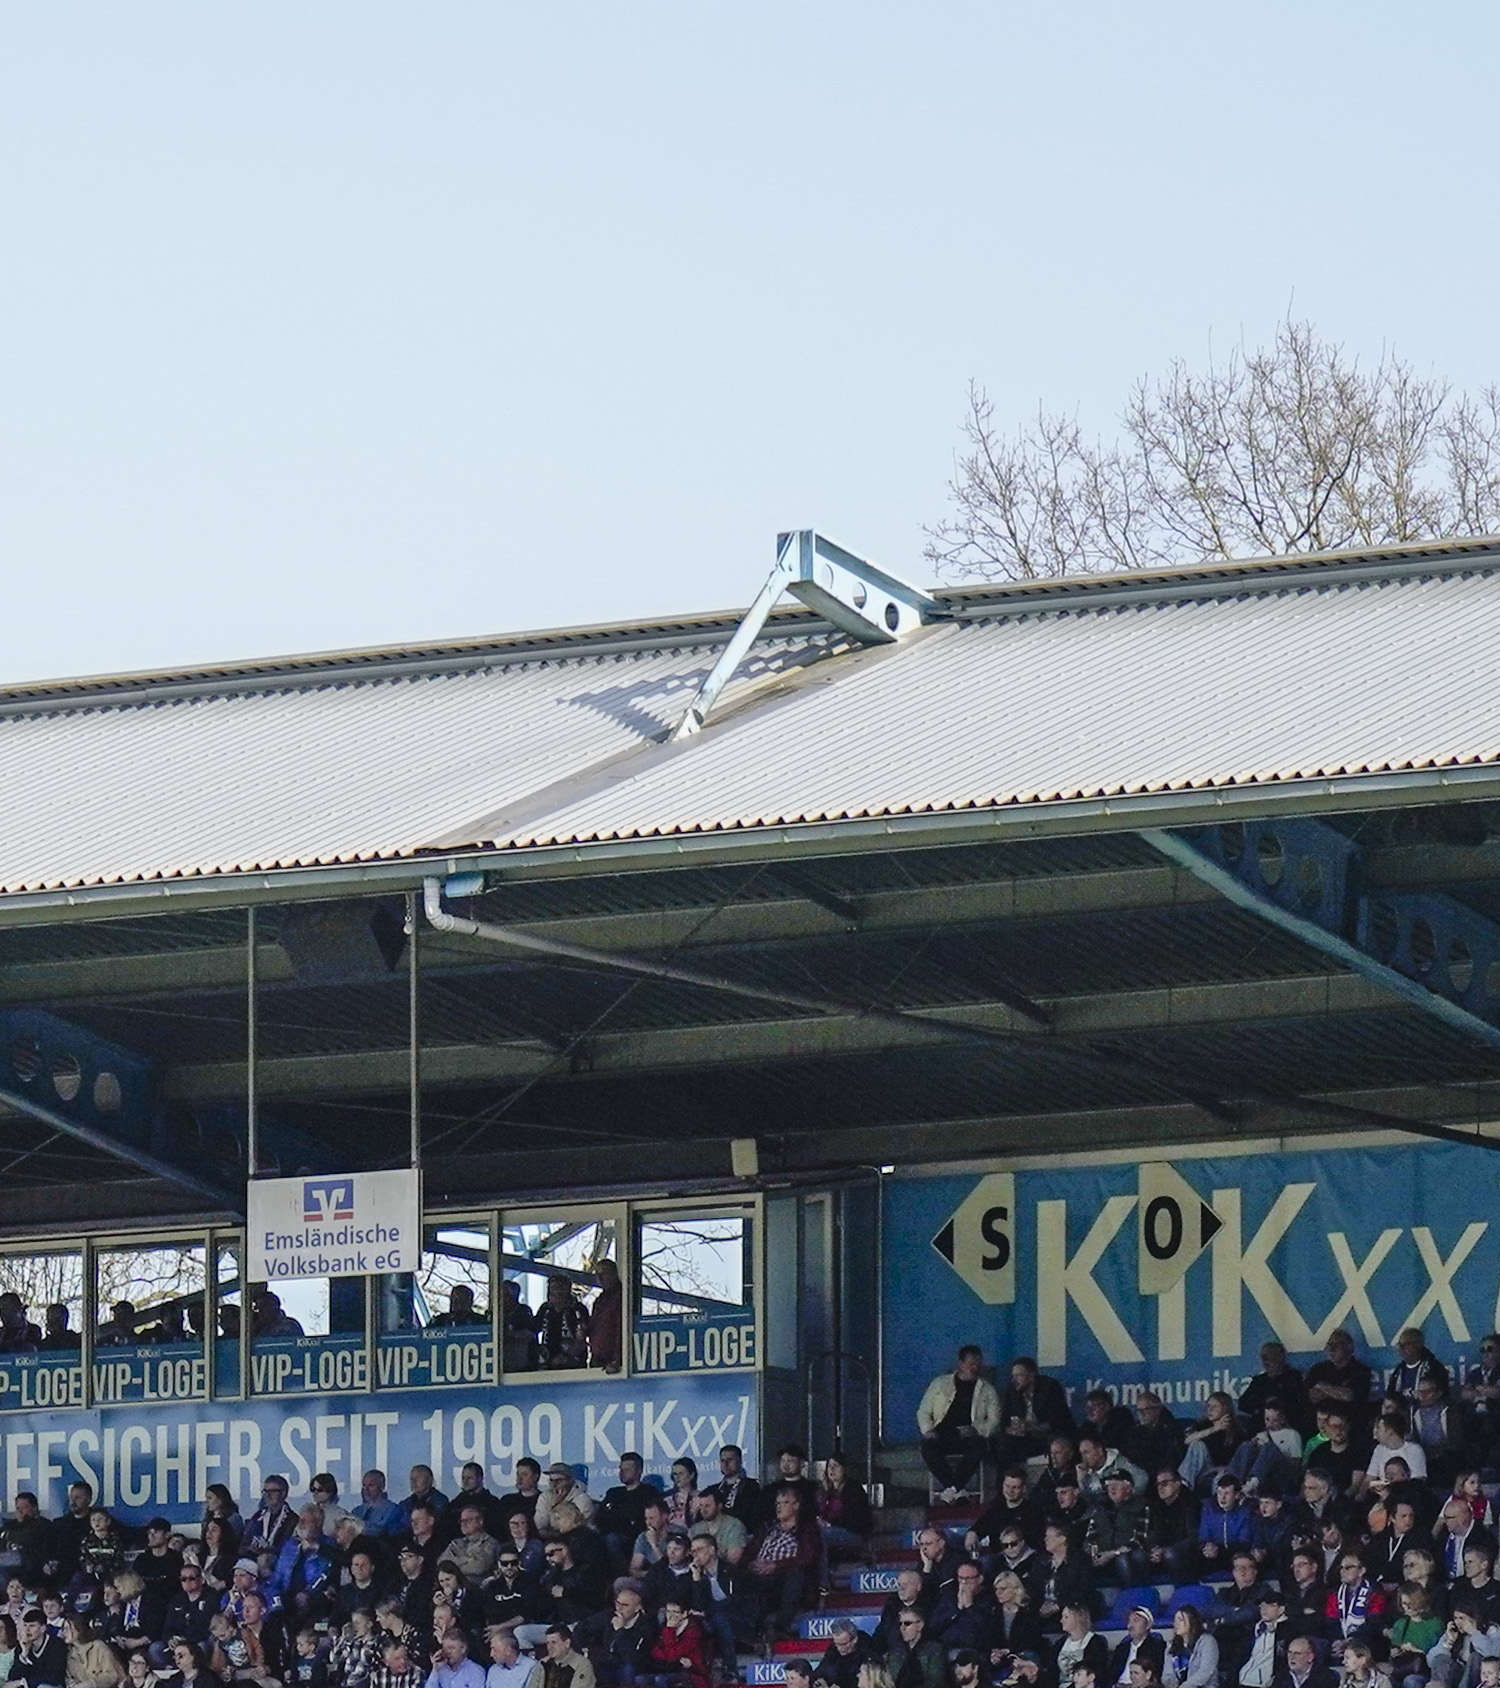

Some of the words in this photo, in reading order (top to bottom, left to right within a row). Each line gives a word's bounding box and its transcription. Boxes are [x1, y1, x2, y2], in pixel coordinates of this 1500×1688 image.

[264, 1222, 400, 1252] Emsländische
[981, 1206, 1011, 1271] S
[1144, 1196, 1182, 1260] O
[264, 1251, 368, 1279] Volksbank
[375, 1250, 401, 1270] eG
[378, 1341, 494, 1384] VIP-LOGE
[633, 1326, 756, 1371] VIP-LOGE
[93, 1358, 206, 1400] VIP-LOGE
[251, 1350, 366, 1394] VIP-LOGE
[280, 1410, 399, 1496] SEIT
[424, 1402, 563, 1486] 1999
[584, 1396, 748, 1465] KiKxxl
